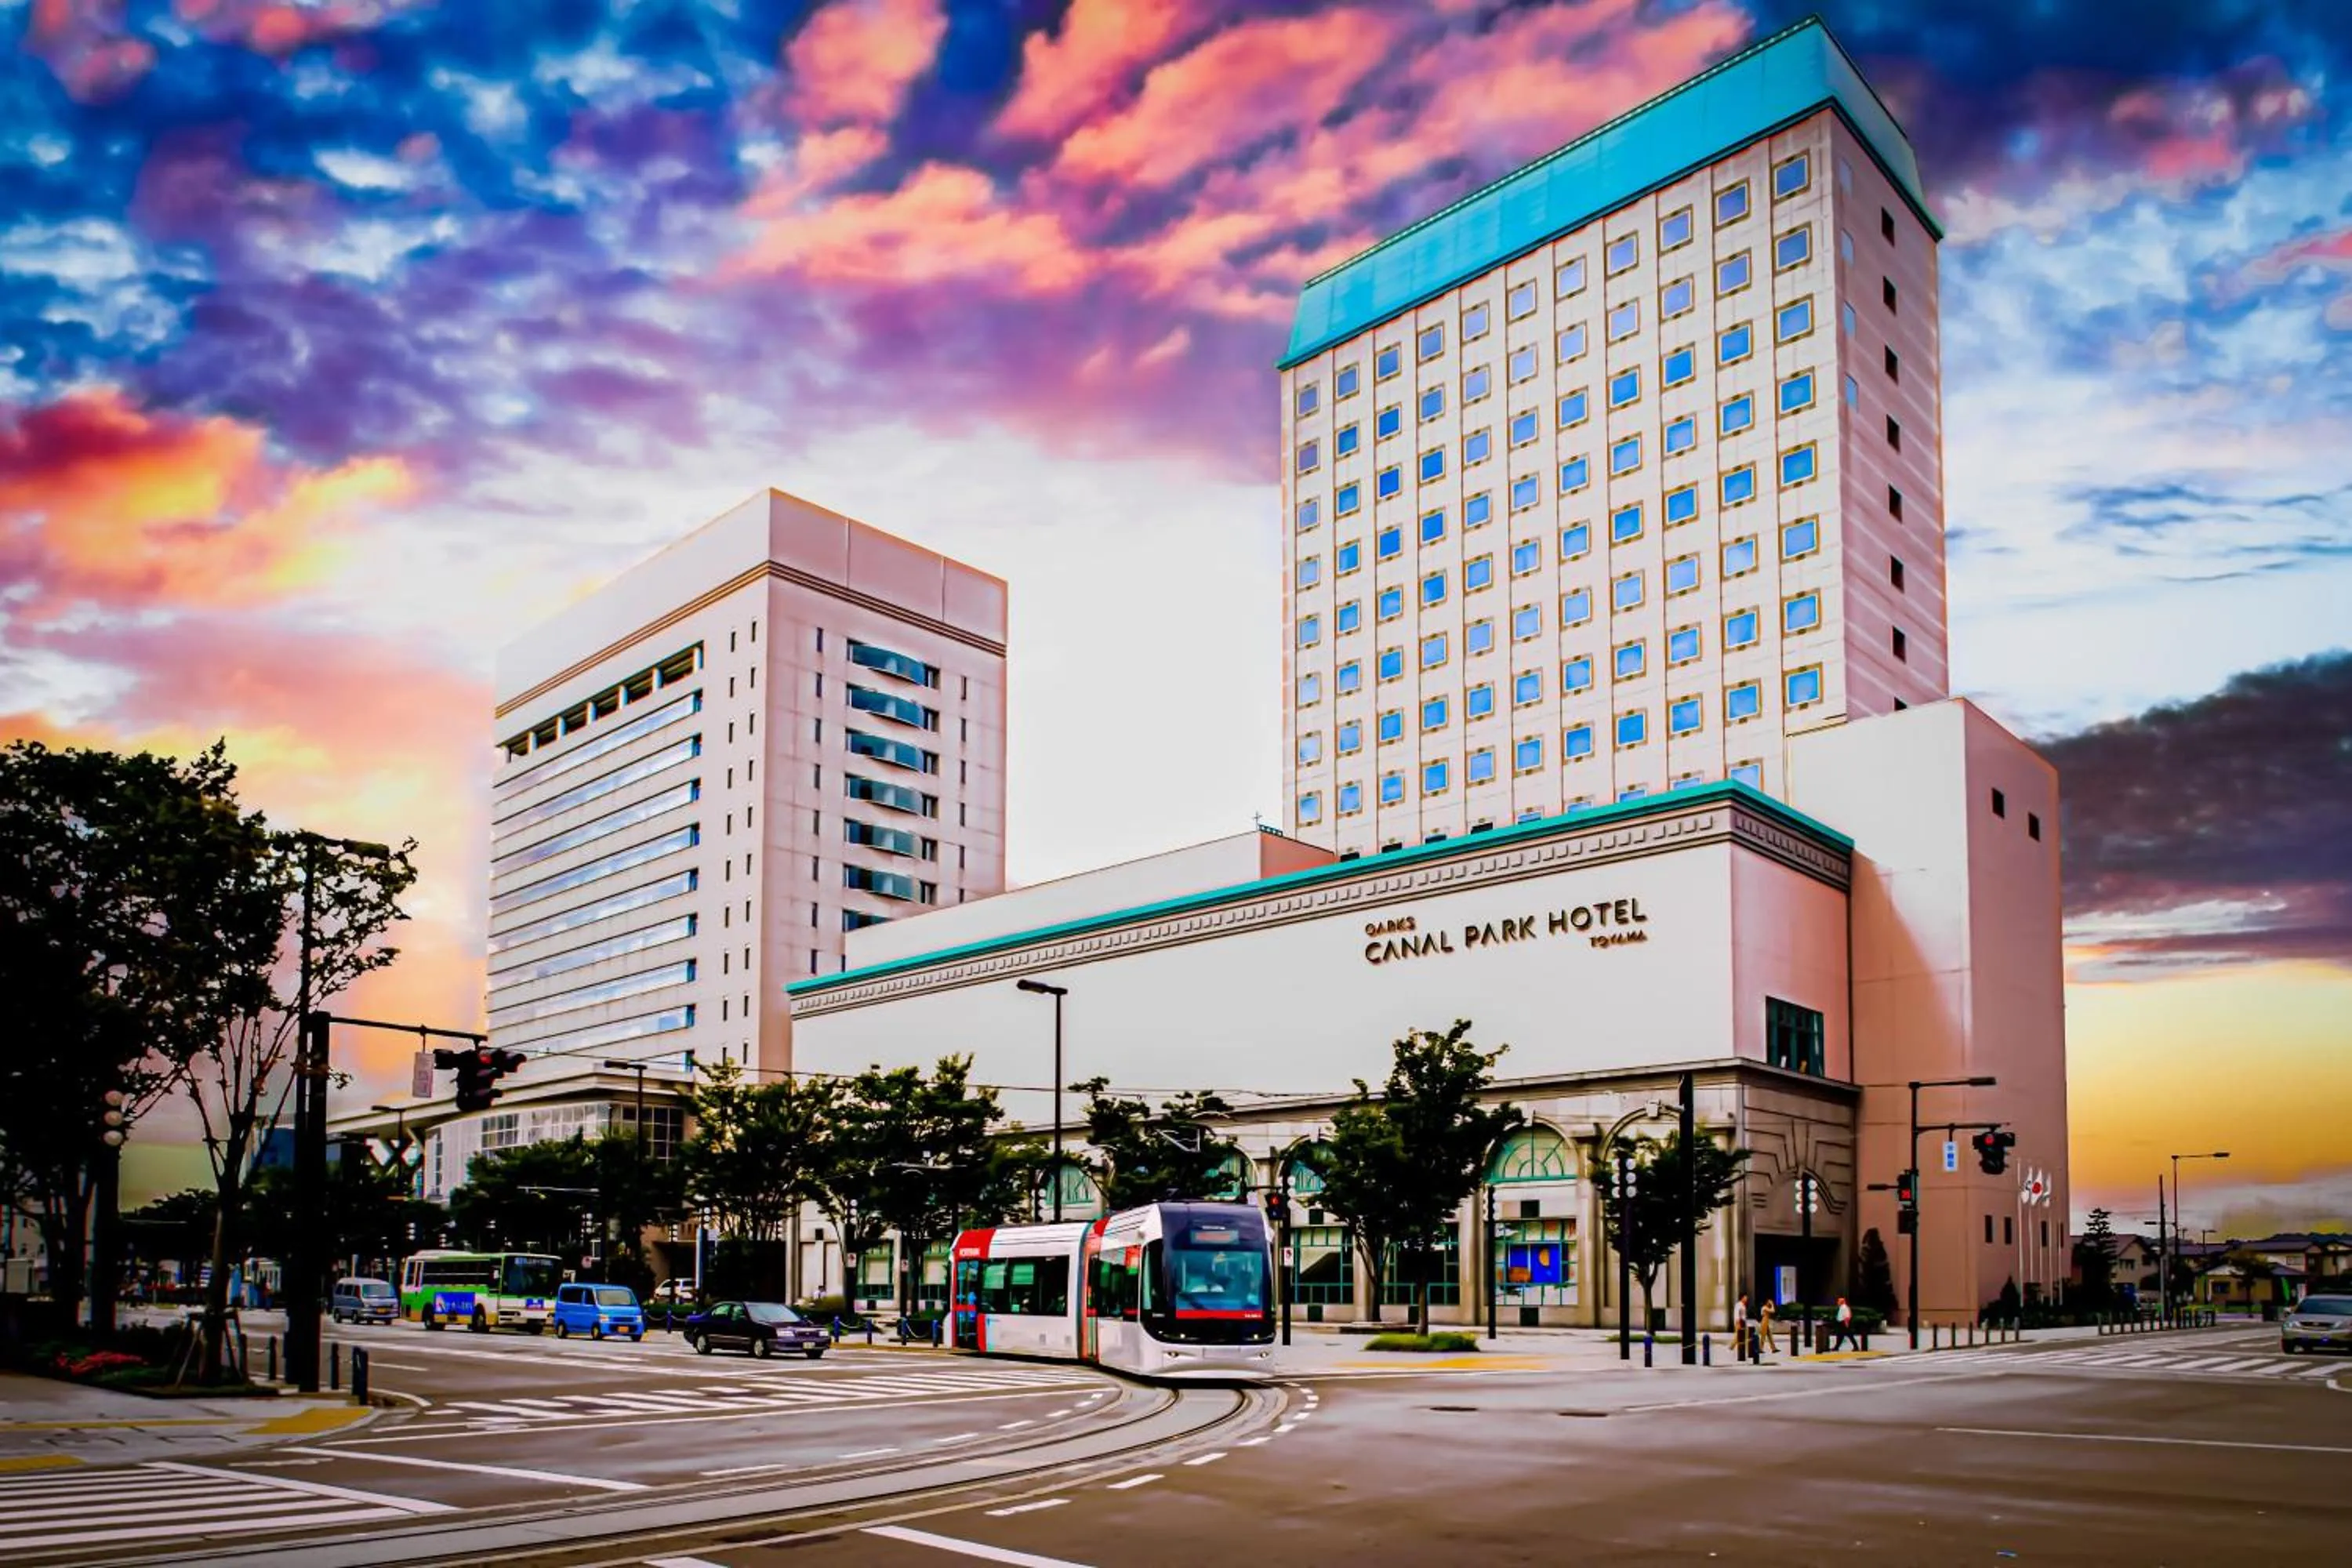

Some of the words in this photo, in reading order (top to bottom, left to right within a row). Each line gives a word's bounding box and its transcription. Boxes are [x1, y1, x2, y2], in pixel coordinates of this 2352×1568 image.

[1365, 930, 1454, 964] CANAL
[1465, 915, 1537, 949] PARK
[1548, 898, 1646, 935] HOTEL
